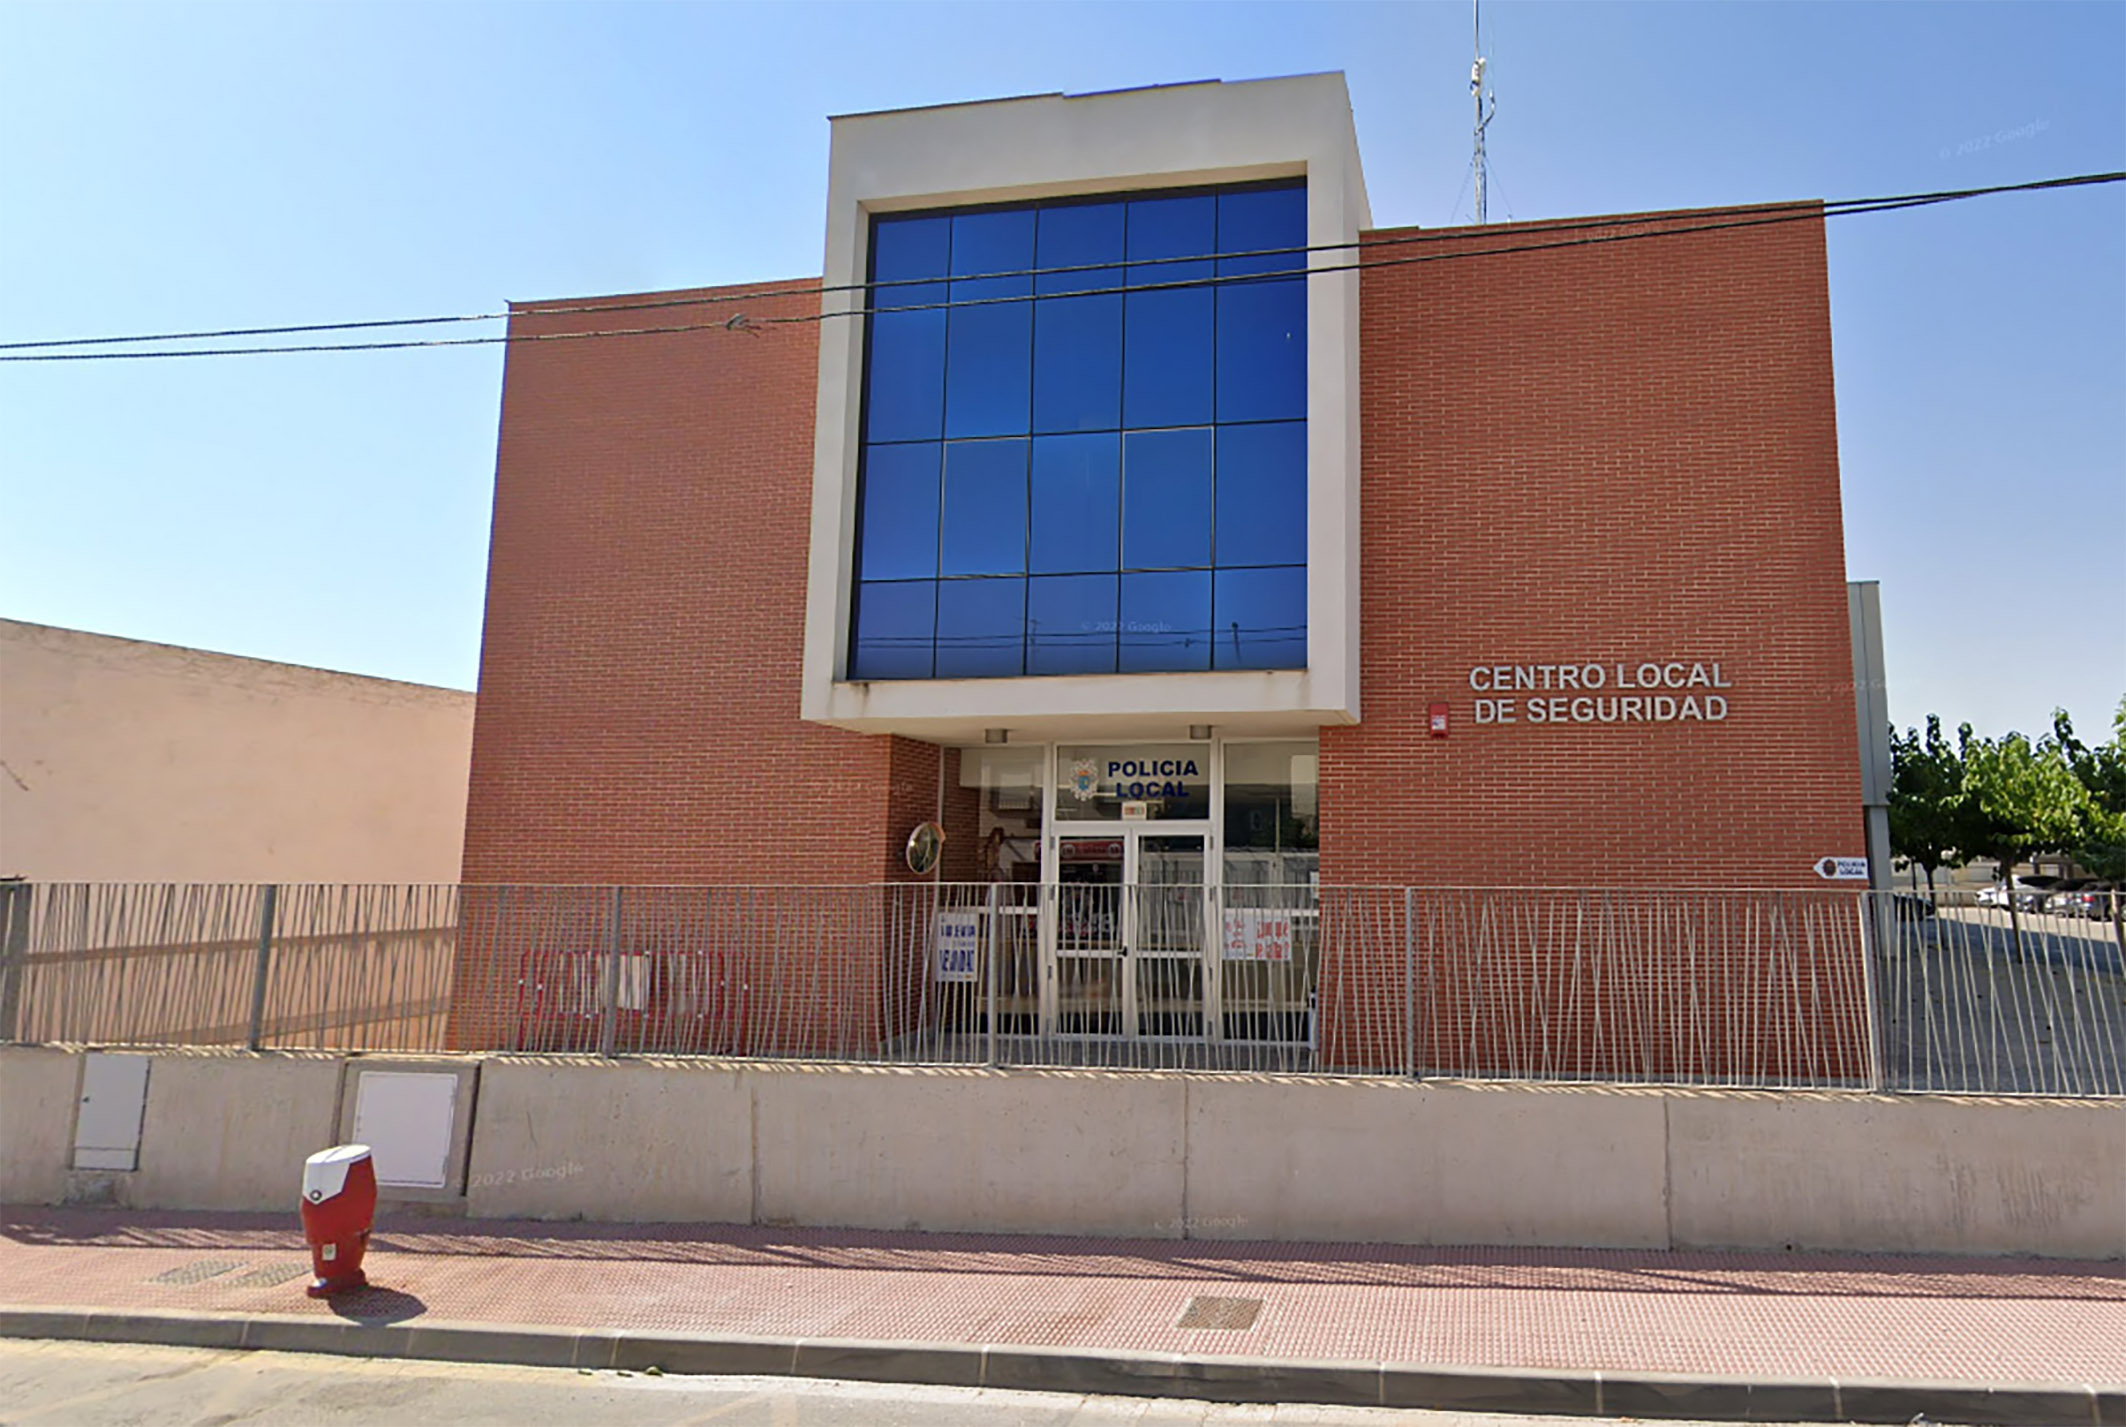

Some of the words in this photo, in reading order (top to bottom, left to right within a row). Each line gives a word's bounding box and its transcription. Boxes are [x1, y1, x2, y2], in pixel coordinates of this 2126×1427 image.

[1469, 663, 1606, 691] CENTRO
[1616, 662, 1732, 689] LOCAL
[1474, 698, 1517, 724] DE
[1526, 695, 1728, 723] SEGURIDAD
[1108, 760, 1199, 778] POLICIA
[1115, 781, 1190, 799] LOCAL
